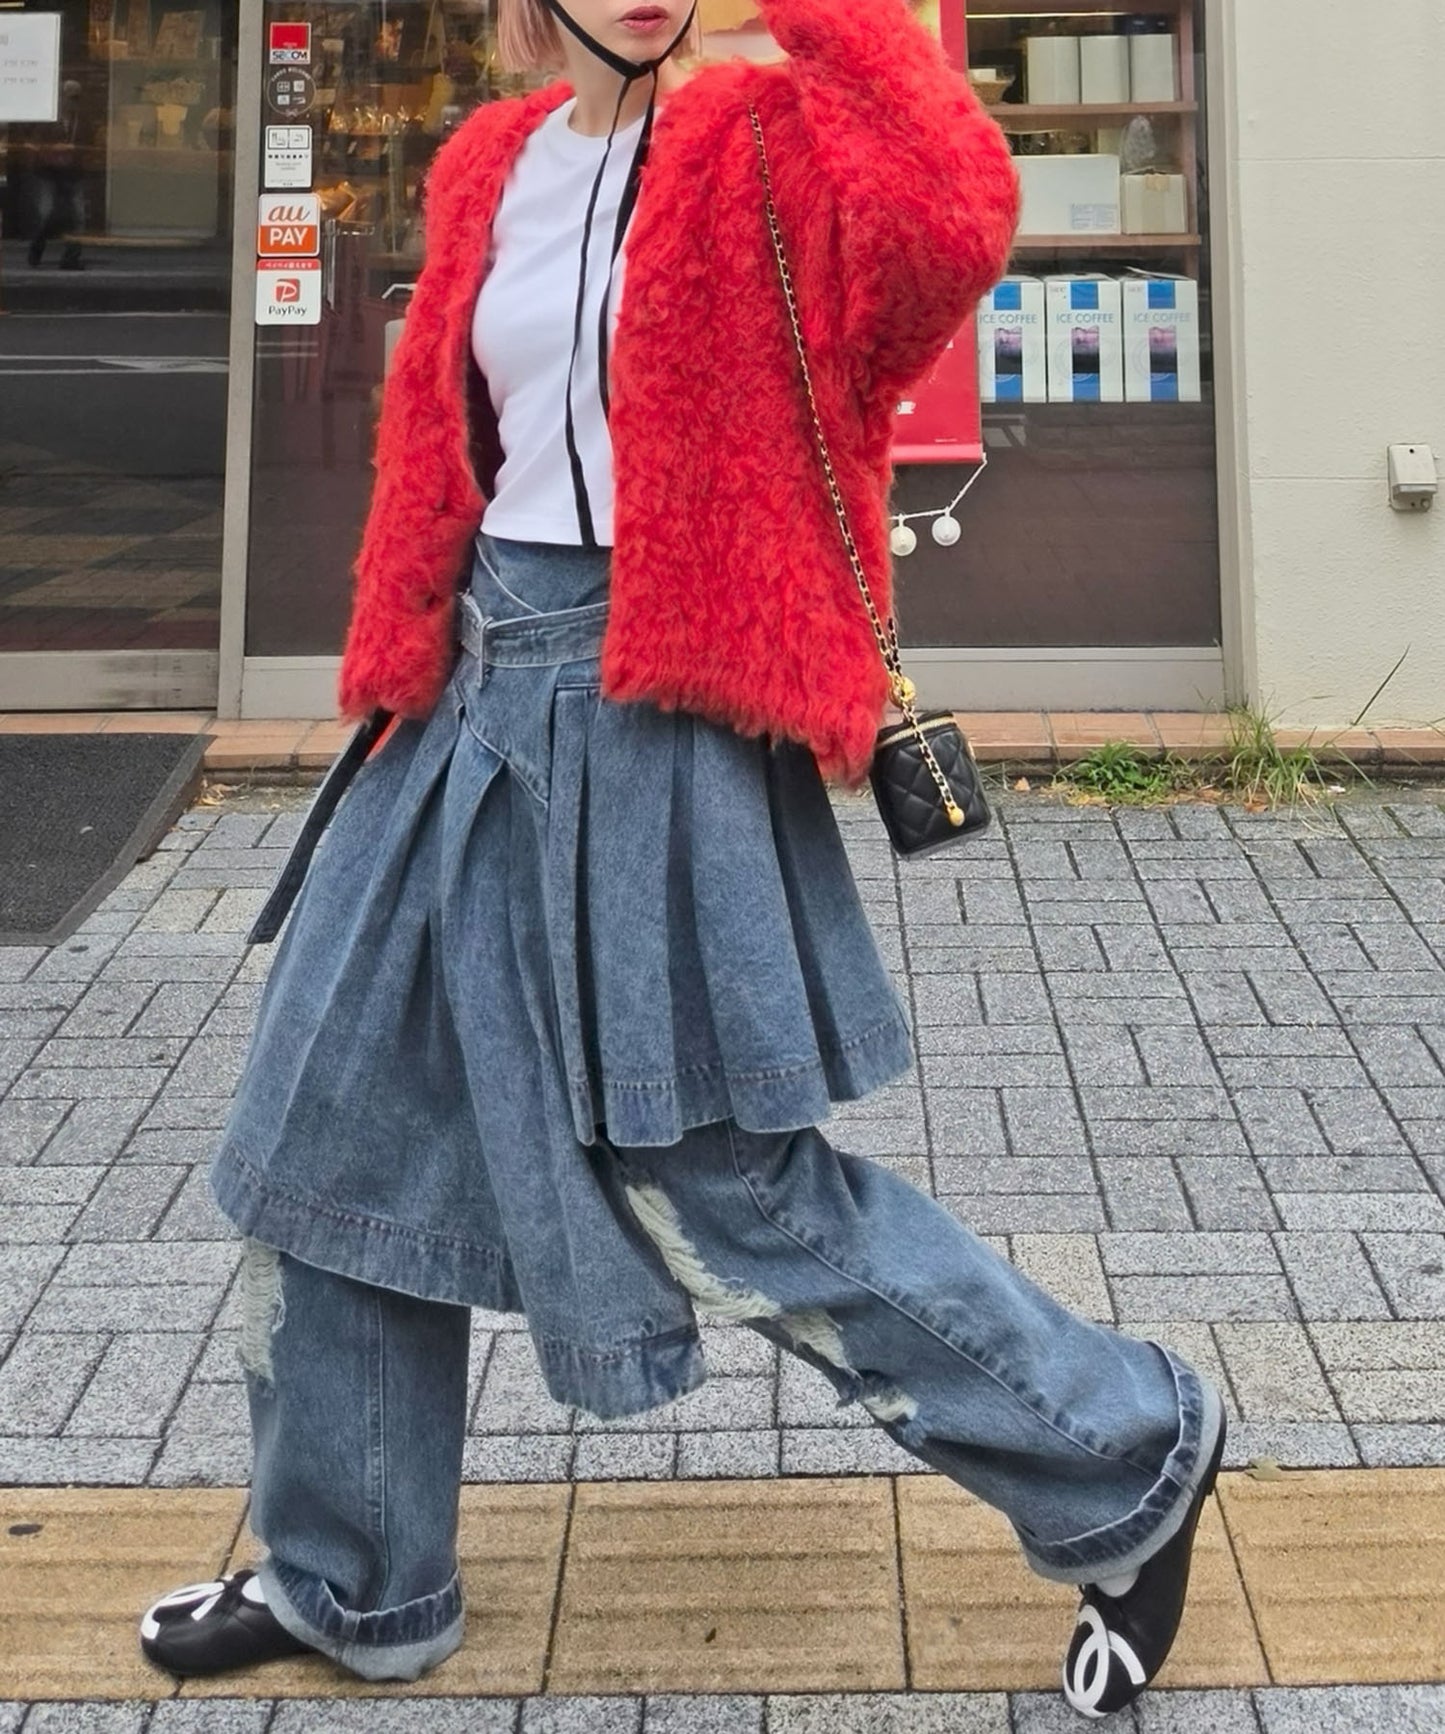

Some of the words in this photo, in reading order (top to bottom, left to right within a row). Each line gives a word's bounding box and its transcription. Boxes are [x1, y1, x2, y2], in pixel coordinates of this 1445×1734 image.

[268, 205, 311, 222] au
[270, 227, 308, 246] PAY
[268, 305, 307, 317] PayPay
[979, 313, 996, 324] ICE
[998, 313, 1038, 324] COFFEE
[1056, 313, 1072, 324] ICE
[1075, 313, 1114, 324] COFFEE
[1133, 313, 1151, 323] ICE
[1152, 313, 1191, 323] COFFEE
